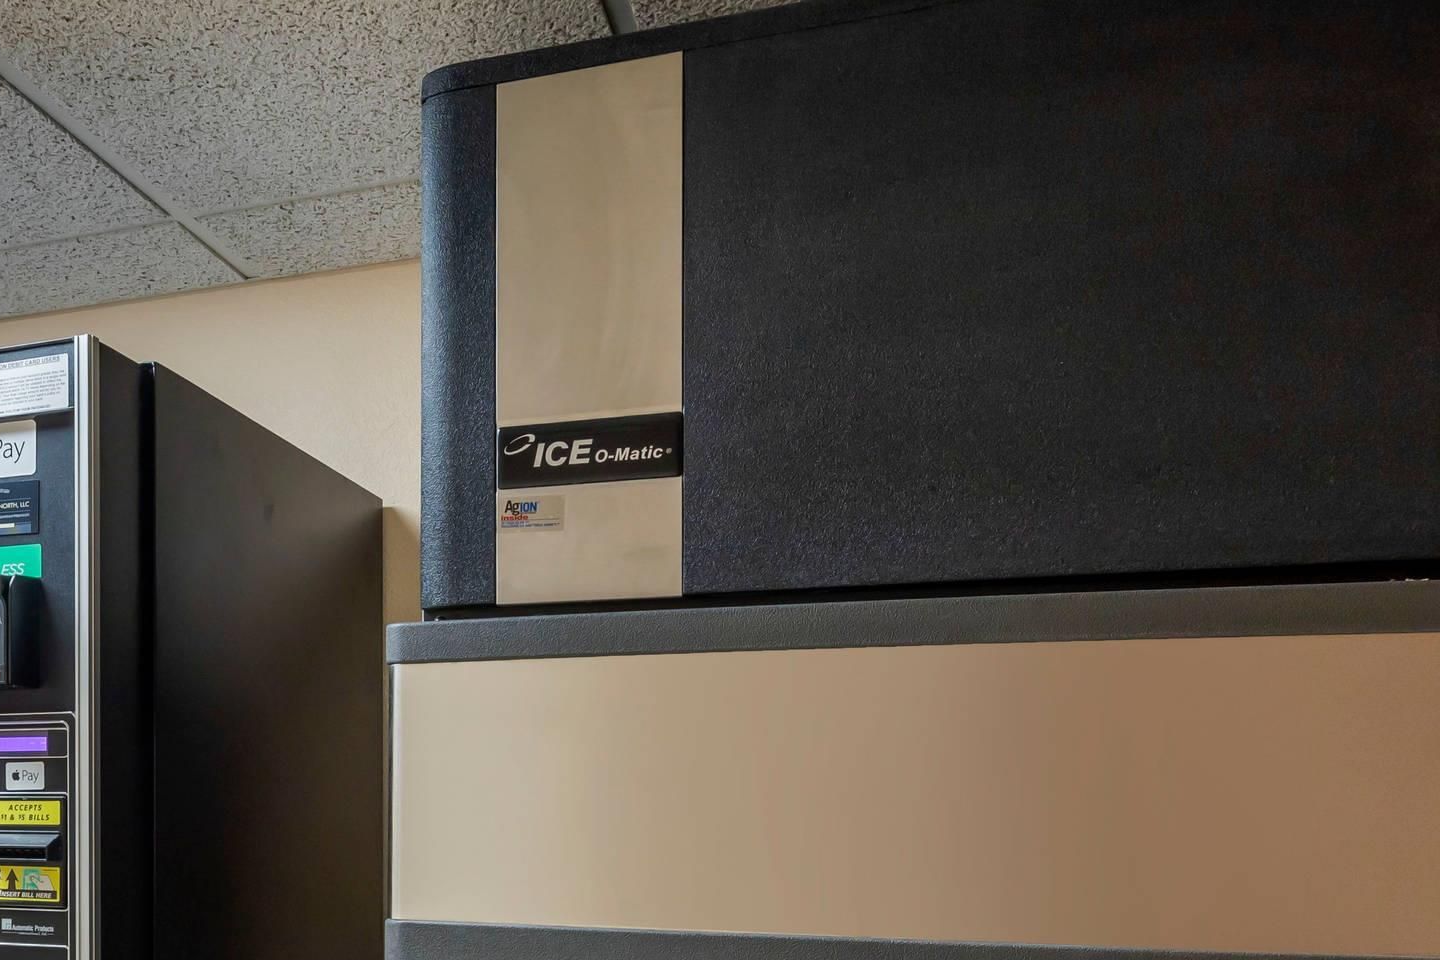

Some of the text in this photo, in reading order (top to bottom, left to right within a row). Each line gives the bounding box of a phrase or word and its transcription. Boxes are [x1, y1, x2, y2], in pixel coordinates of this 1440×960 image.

[533, 438, 594, 468] ICE
[20, 500, 31, 509] LLC
[21, 769, 40, 784] Pay
[8, 804, 43, 812] ACCEPTS
[28, 813, 51, 821] BILLS
